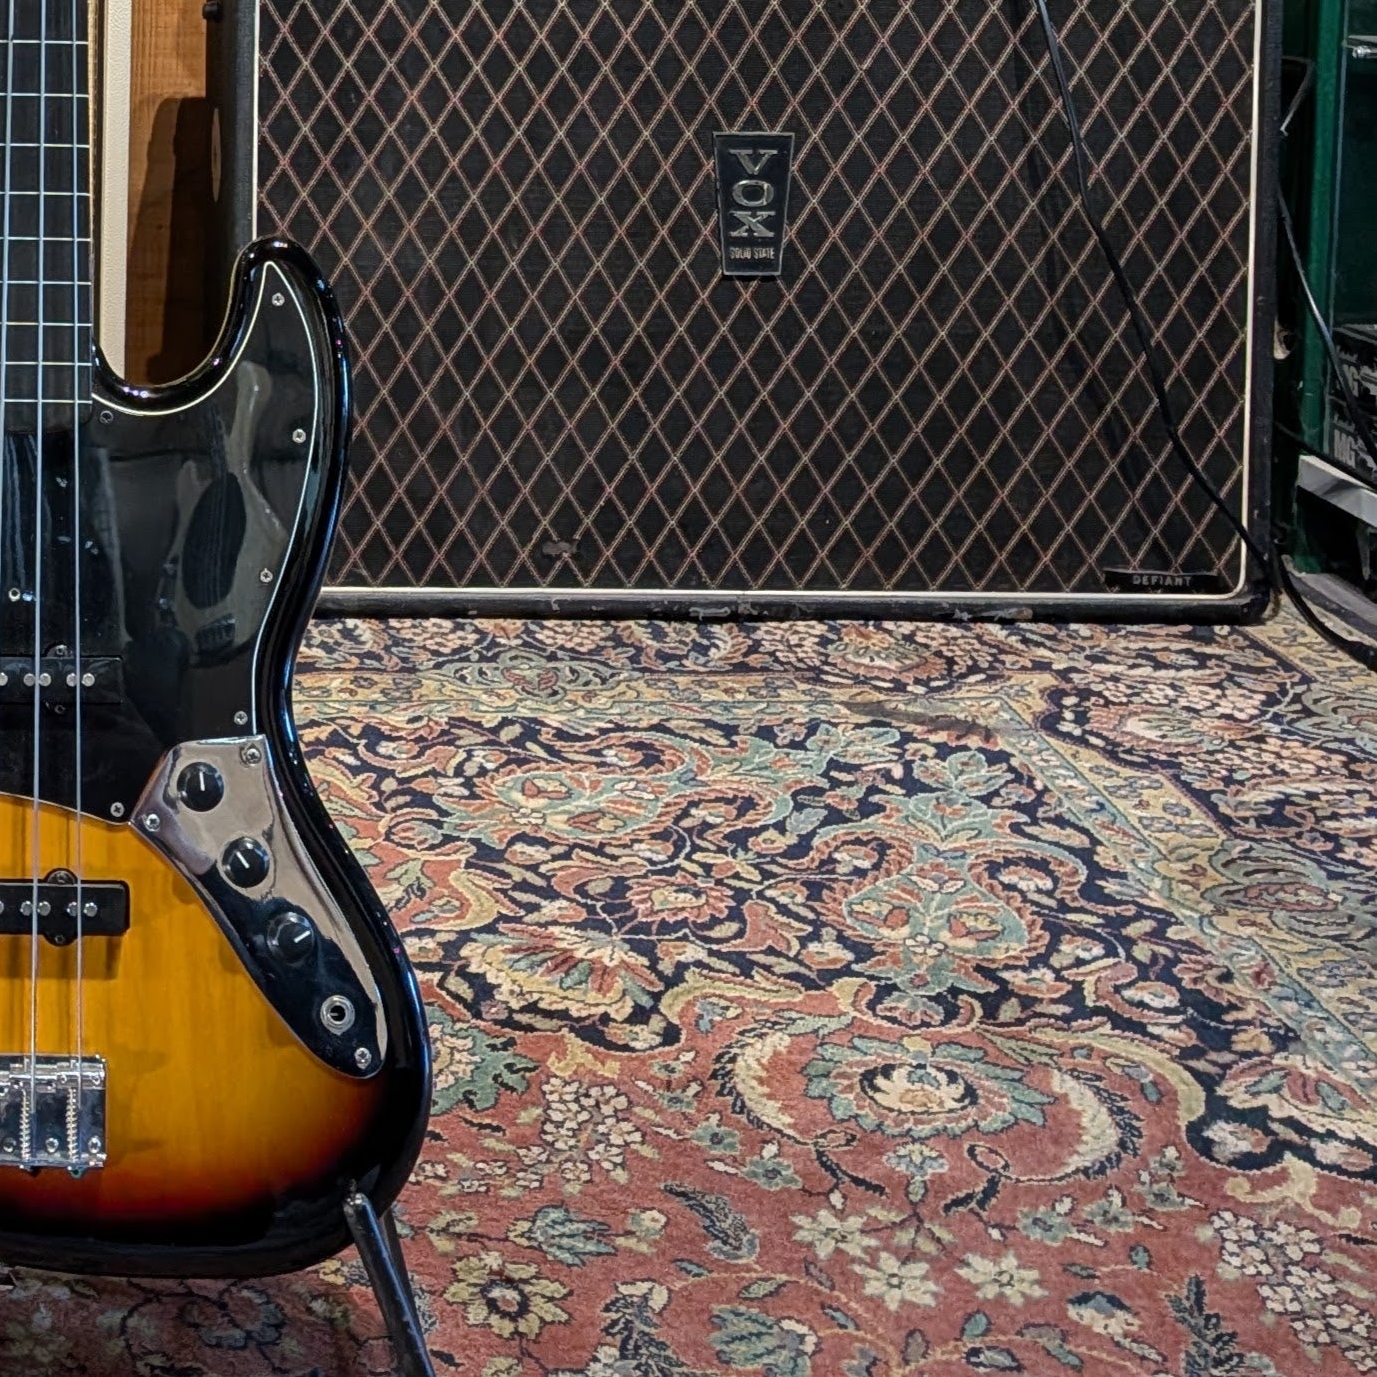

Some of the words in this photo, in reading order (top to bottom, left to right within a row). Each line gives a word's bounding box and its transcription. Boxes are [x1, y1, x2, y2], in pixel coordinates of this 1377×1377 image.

[728, 149, 778, 238] VOX
[753, 246, 775, 260] STATE
[1132, 574, 1192, 587] DEFIANT
